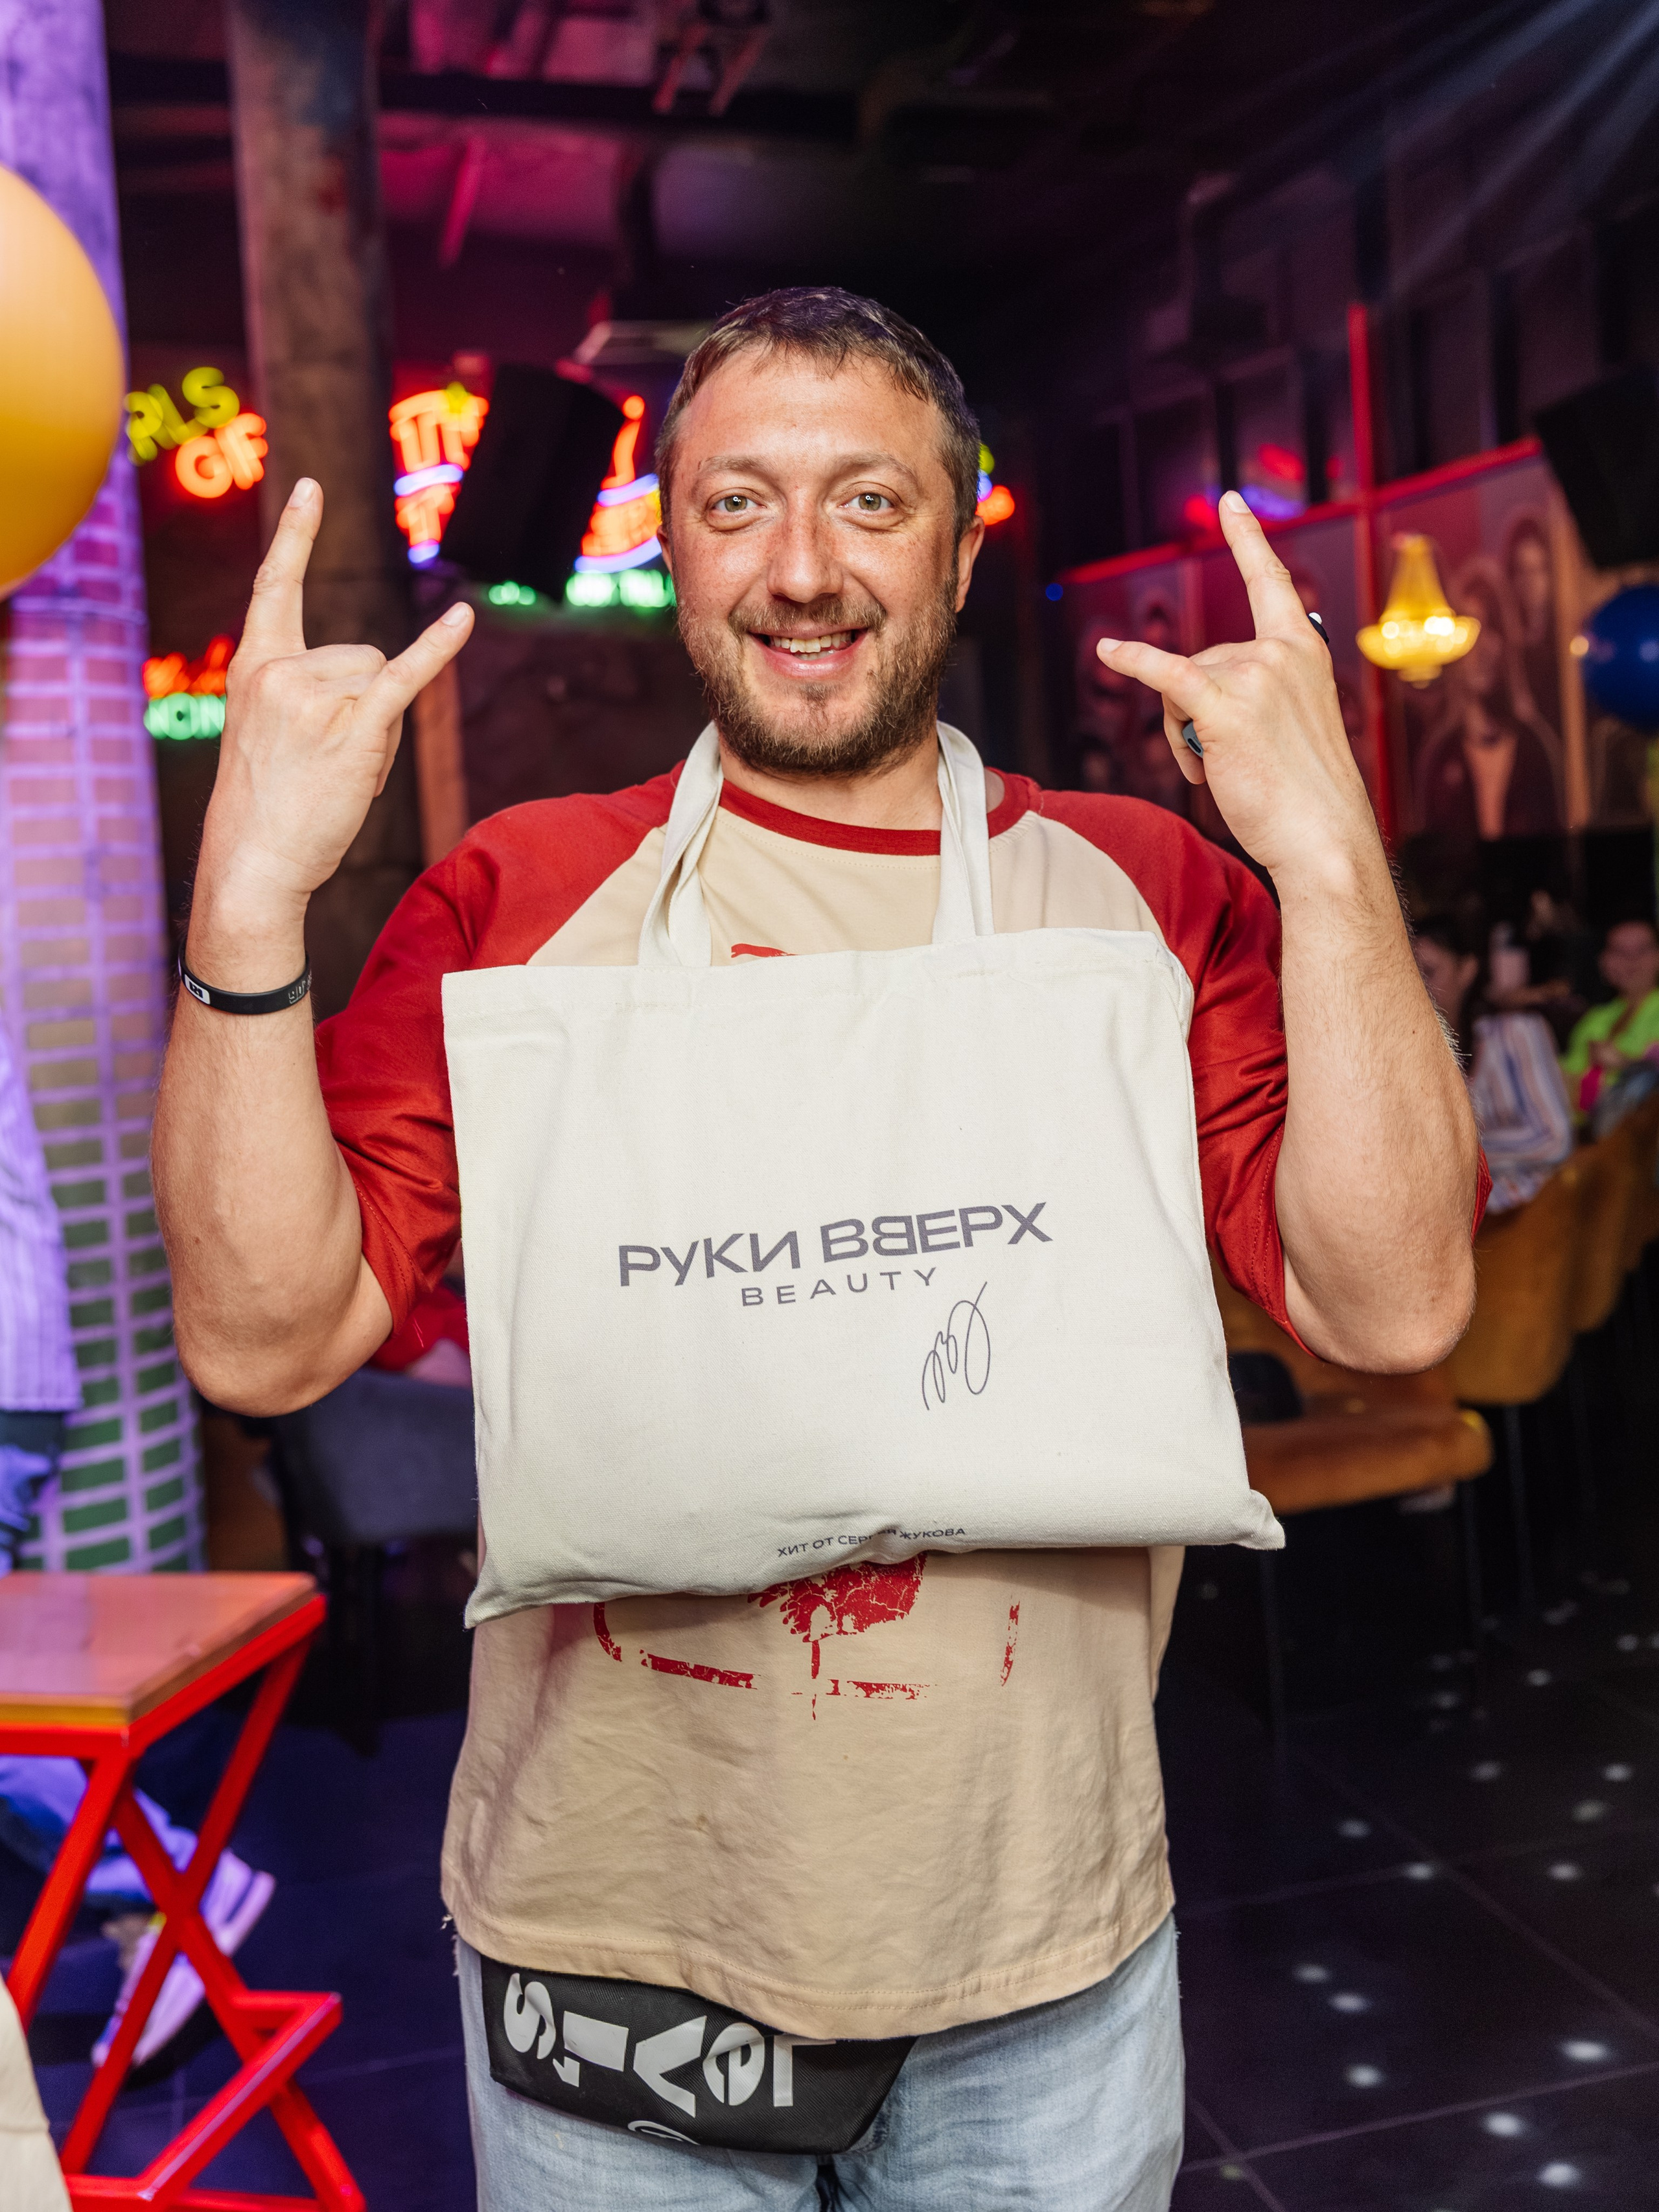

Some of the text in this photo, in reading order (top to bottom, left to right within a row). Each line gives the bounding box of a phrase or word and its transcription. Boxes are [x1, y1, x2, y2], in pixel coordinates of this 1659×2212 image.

[618, 1229, 801, 1287] РУКИ
[741, 1267, 937, 1307] BEAUTY
[778, 1542, 809, 1557] ХИТ
[813, 1536, 834, 1550] ОТ
[899, 1528, 966, 1540] ЖУКОВА
